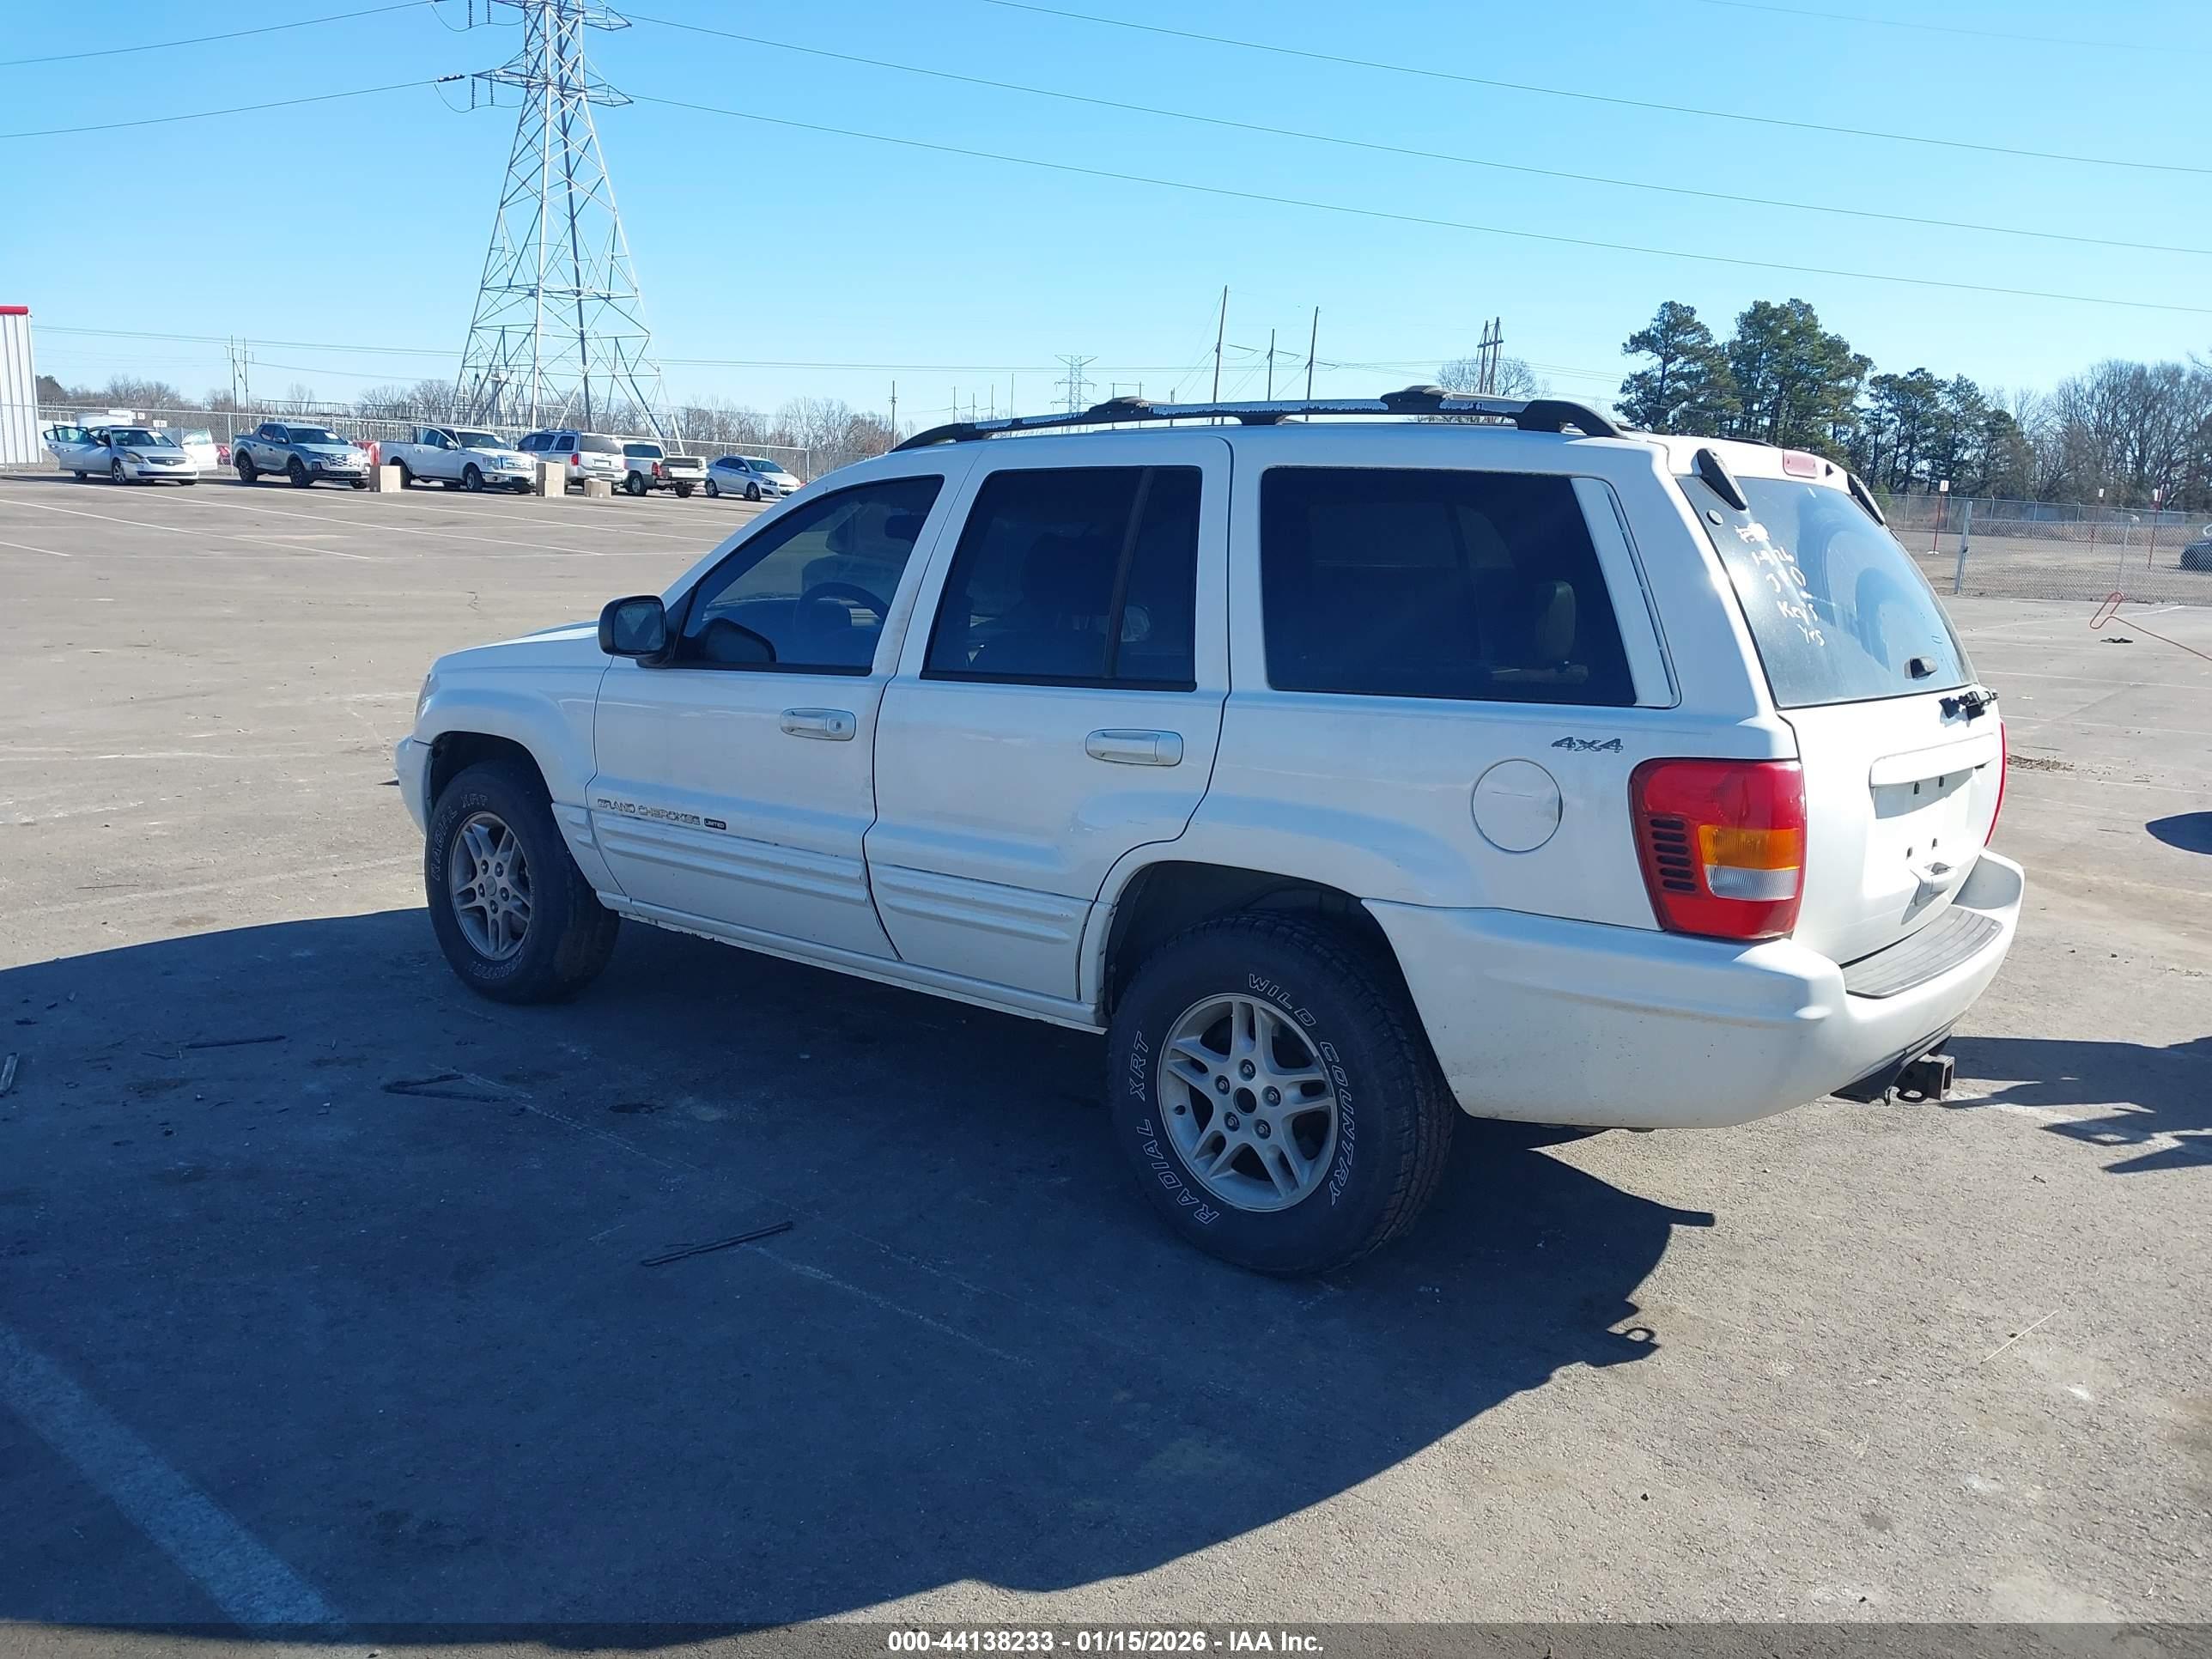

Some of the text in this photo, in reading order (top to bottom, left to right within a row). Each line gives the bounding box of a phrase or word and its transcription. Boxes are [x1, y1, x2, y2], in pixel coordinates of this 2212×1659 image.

[597, 799, 635, 814] GRAND
[1128, 1030, 1220, 1224] RADIAL XRT
[1249, 973, 1356, 1206] WILD COUNTRY
